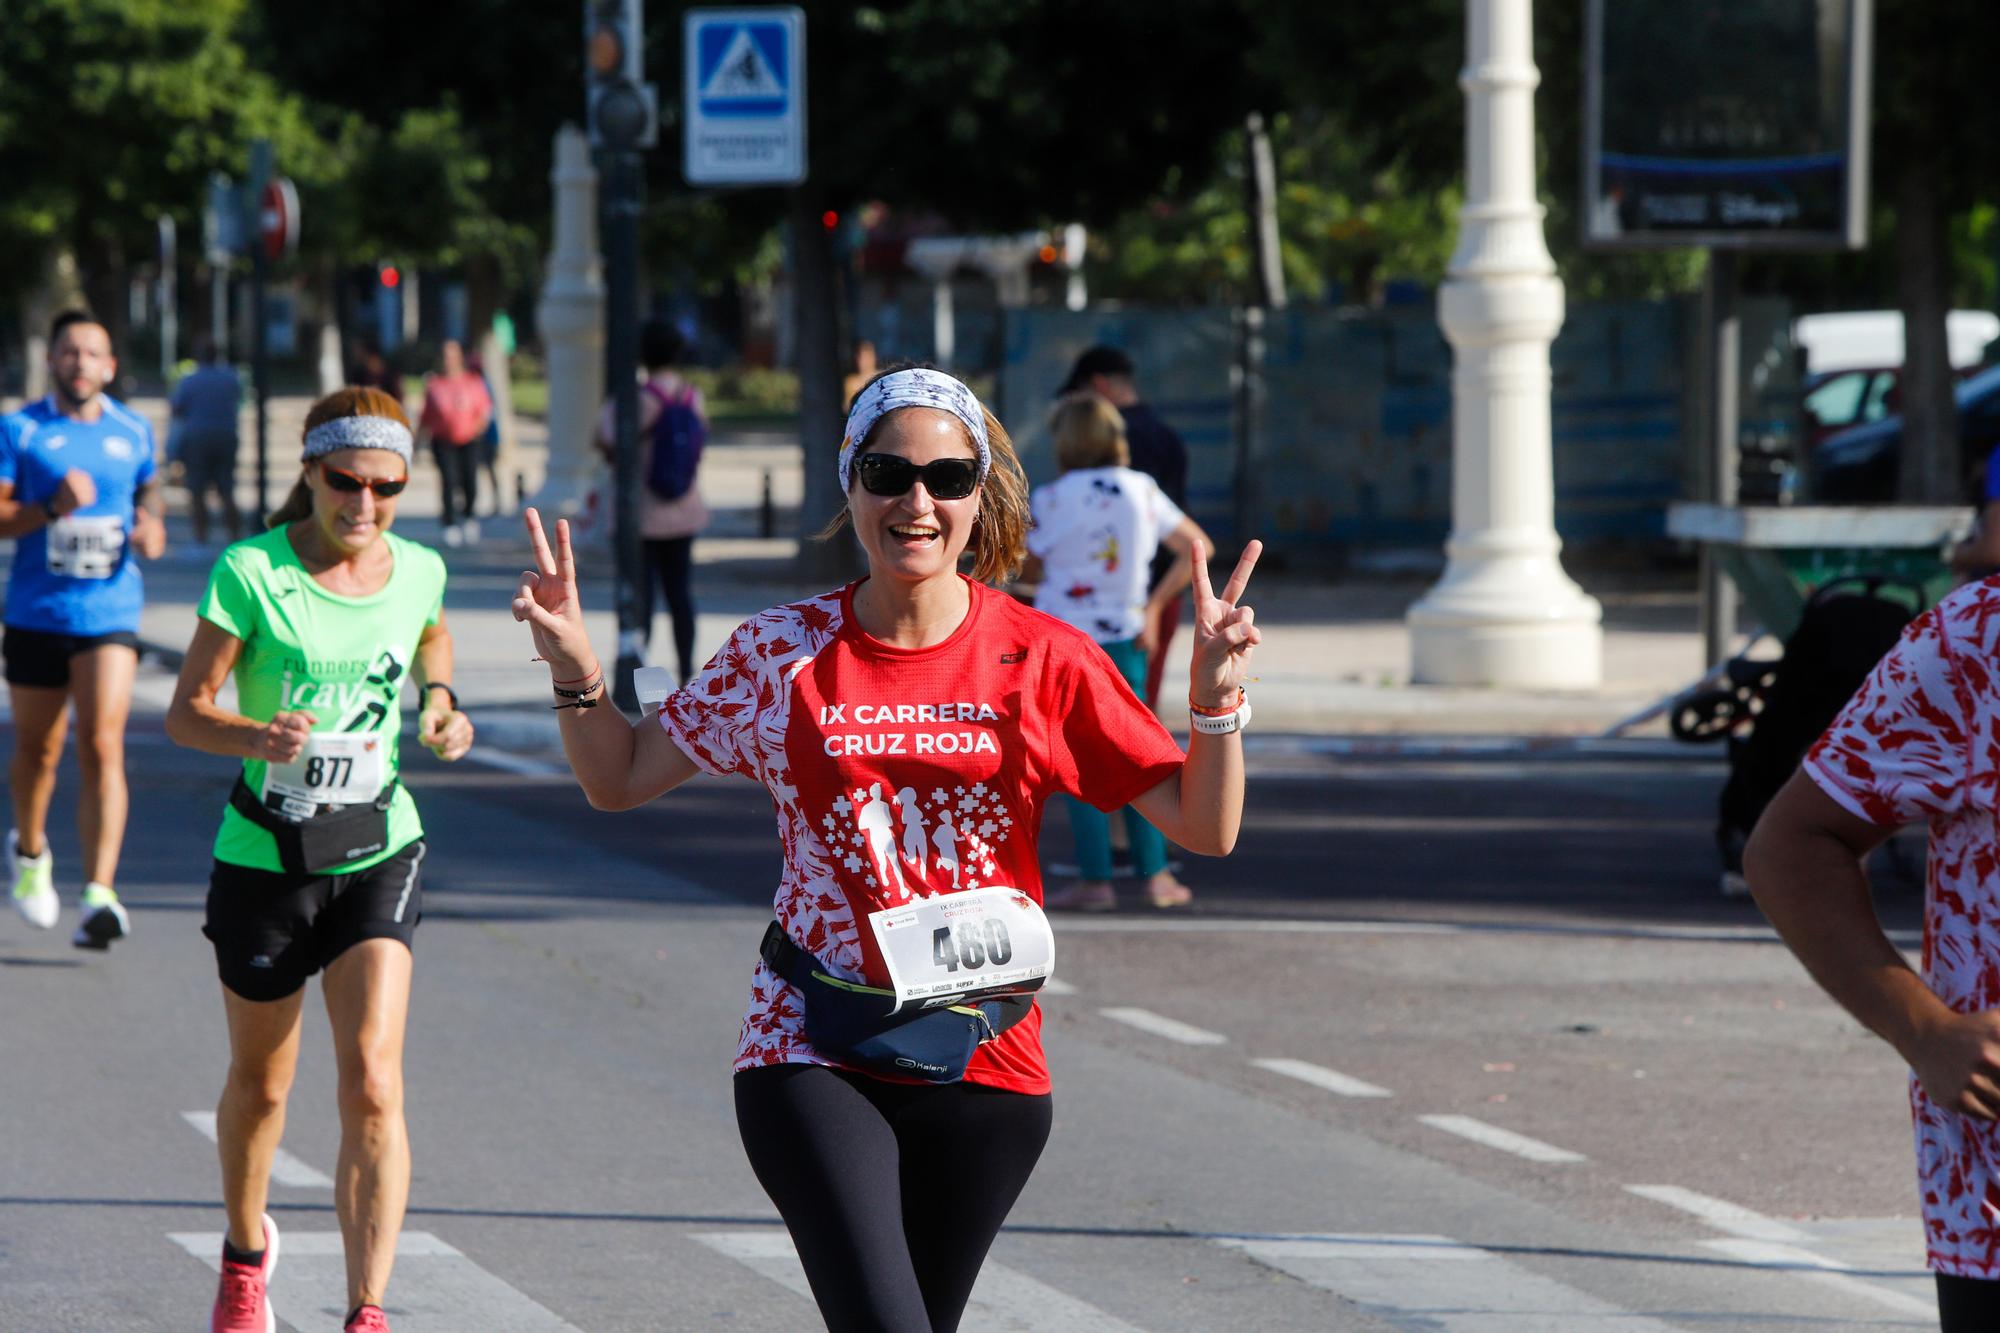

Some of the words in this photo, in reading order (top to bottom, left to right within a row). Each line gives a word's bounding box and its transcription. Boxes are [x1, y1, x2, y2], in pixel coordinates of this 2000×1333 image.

[283, 657, 369, 674] runners
[820, 703, 847, 726] IX
[854, 702, 999, 725] CARRERA
[824, 733, 906, 757] CRUZ
[915, 732, 997, 754] ROJA
[304, 756, 353, 788] 877
[932, 918, 1013, 973] 460
